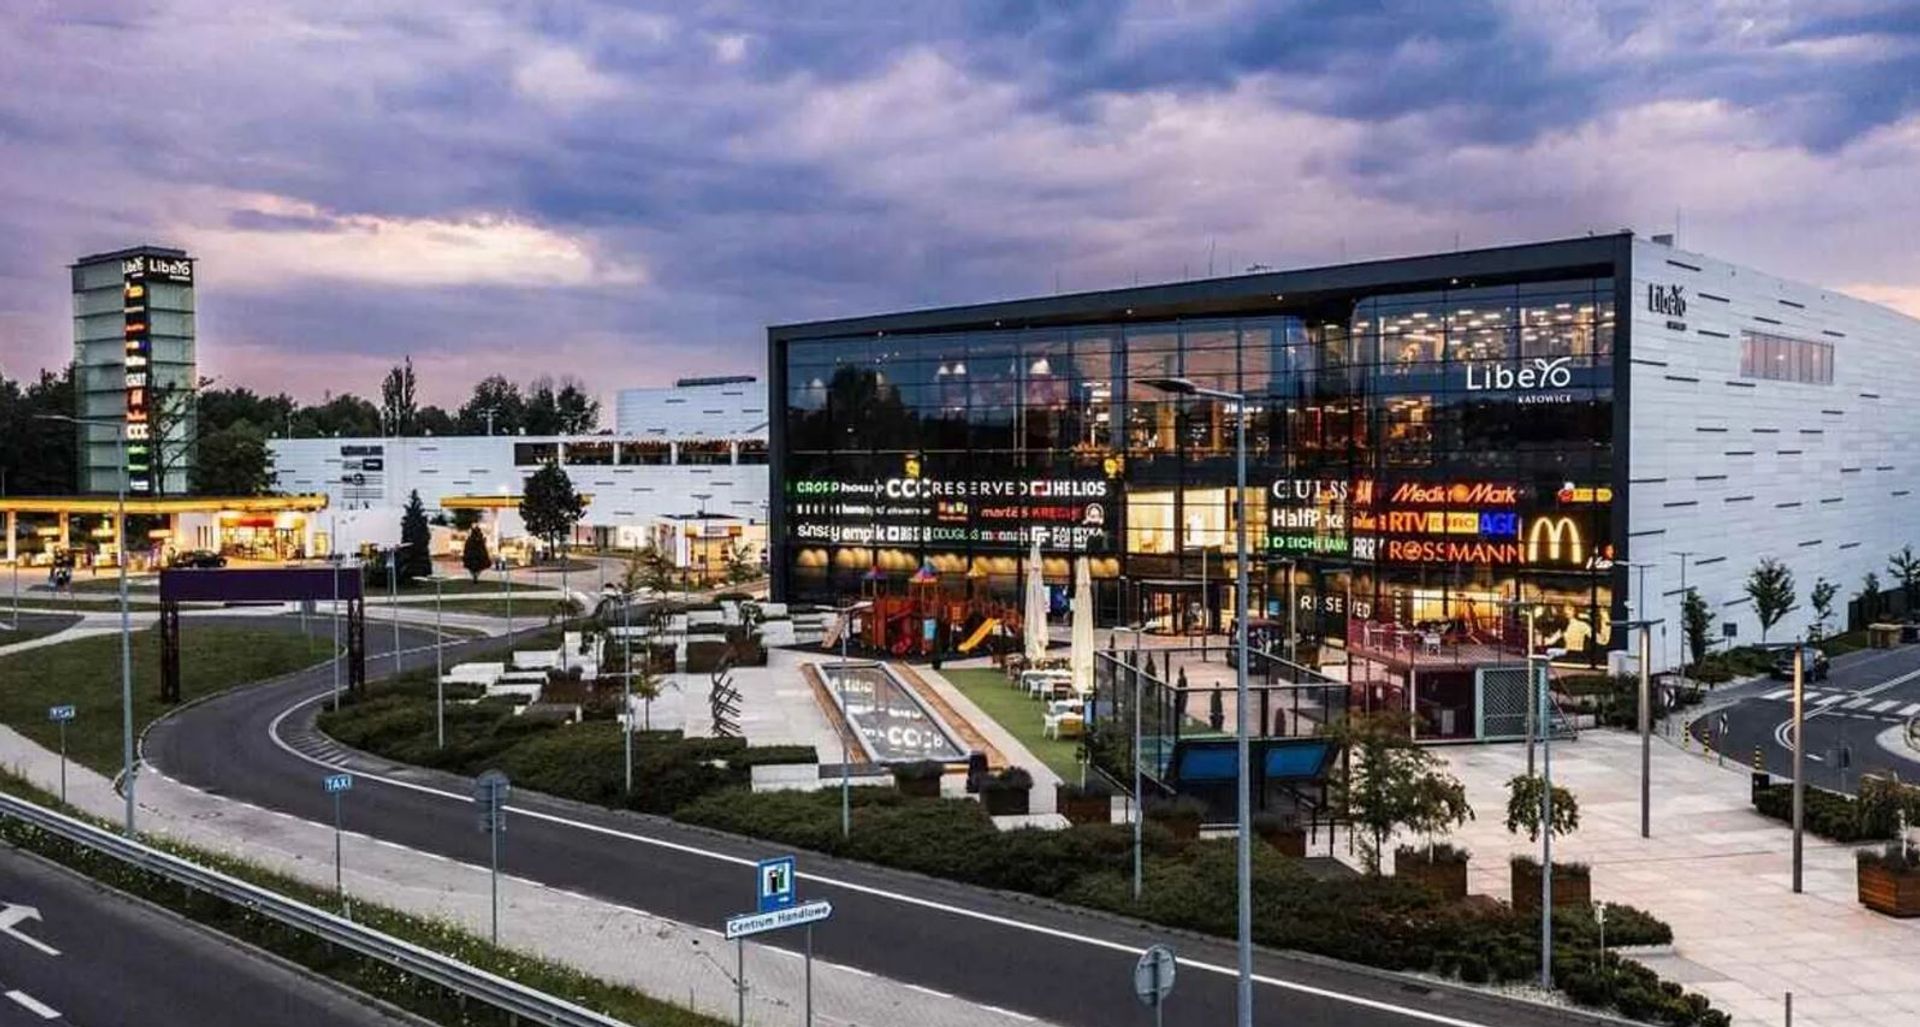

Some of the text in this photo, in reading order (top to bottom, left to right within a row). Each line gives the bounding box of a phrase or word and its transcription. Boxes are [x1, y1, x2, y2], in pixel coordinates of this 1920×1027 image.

[1518, 394, 1571, 403] KATOWICE
[932, 481, 1028, 496] RESERVED
[1053, 482, 1107, 496] HELIOS
[1272, 508, 1344, 527] HalfPice
[1389, 512, 1428, 532] RTV
[842, 524, 885, 545] empik
[933, 528, 978, 541] DOUGLS
[1389, 541, 1525, 564] ROSSMANN
[730, 904, 828, 933] Centrum Handlowe
